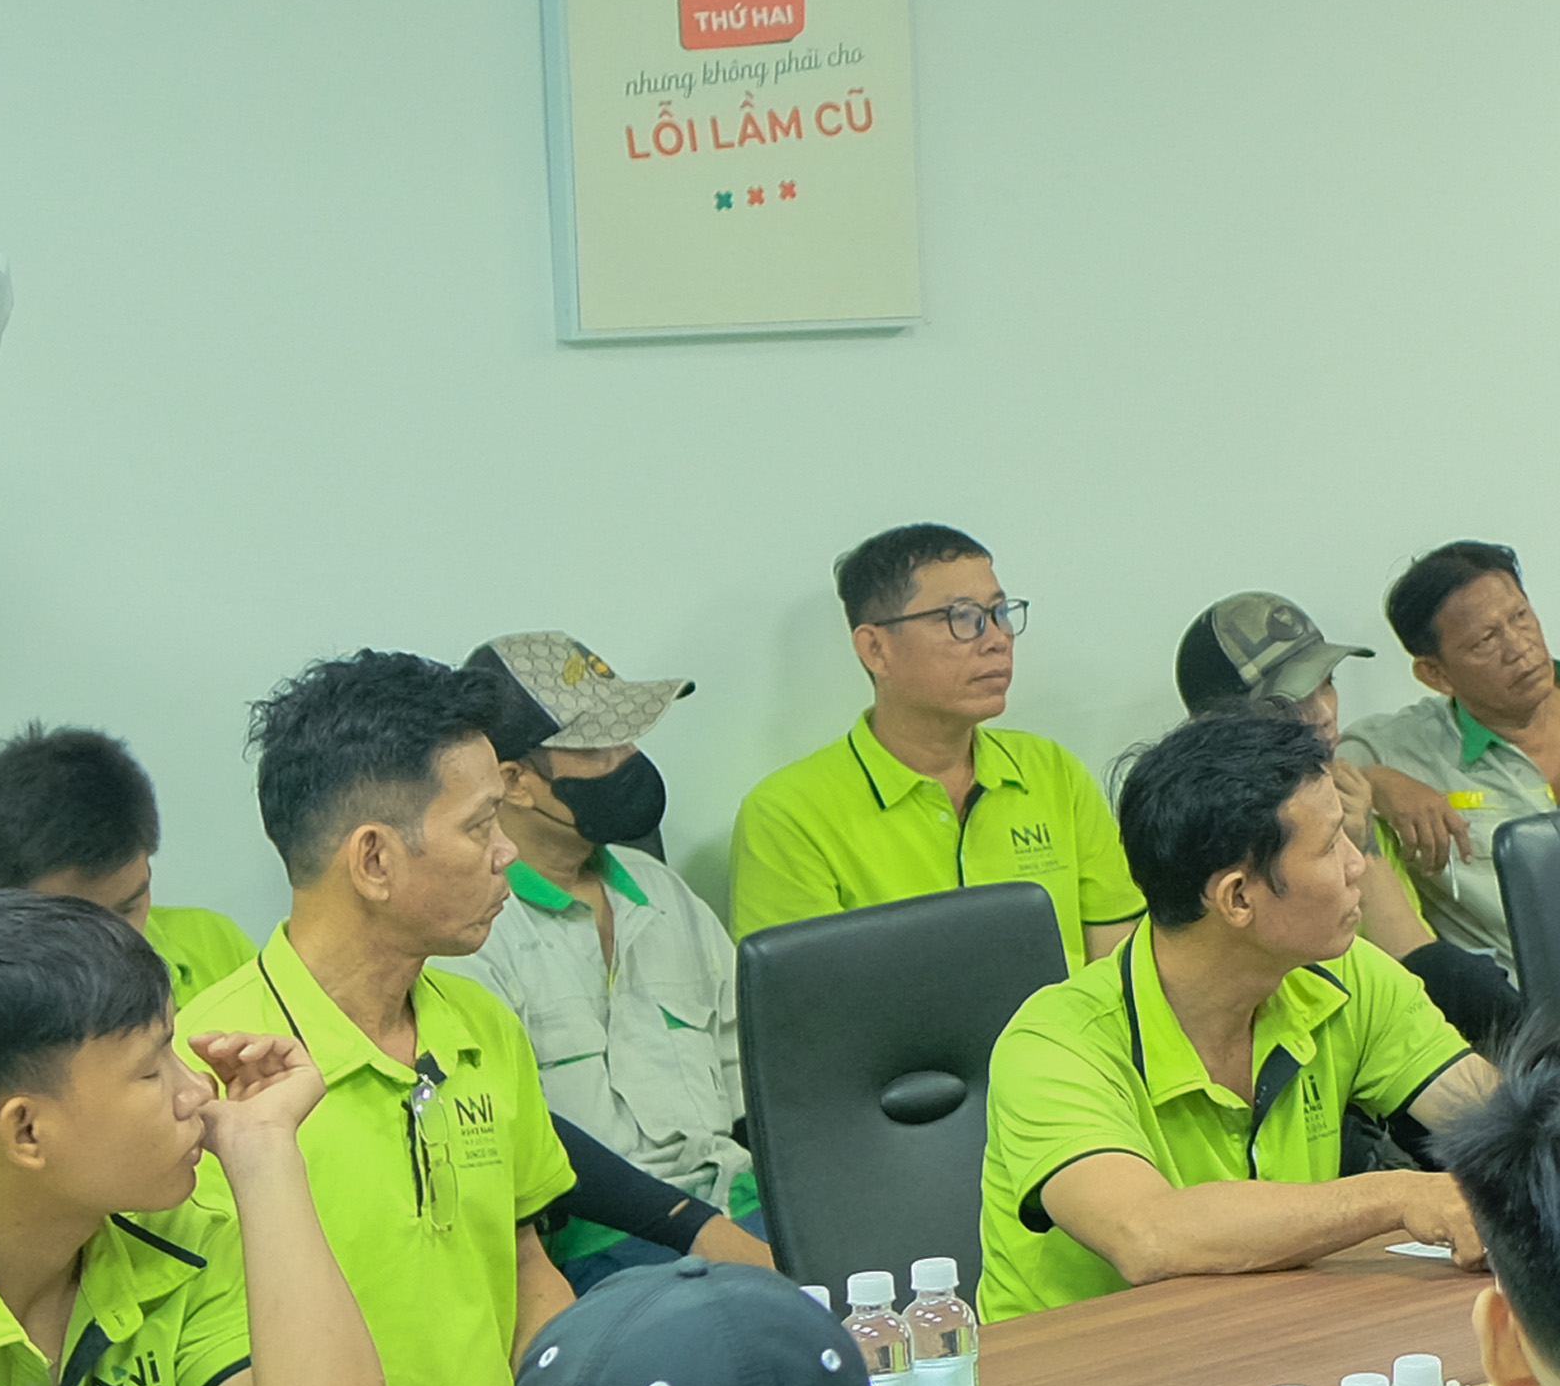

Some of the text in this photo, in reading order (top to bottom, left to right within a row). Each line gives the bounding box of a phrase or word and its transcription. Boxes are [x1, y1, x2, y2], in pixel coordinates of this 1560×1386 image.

[695, 1, 794, 33] THỨ HAI
[702, 60, 768, 89] không
[774, 49, 823, 86] phải
[827, 43, 865, 70] cho
[626, 86, 874, 160] LỖI LẦM CŨ
